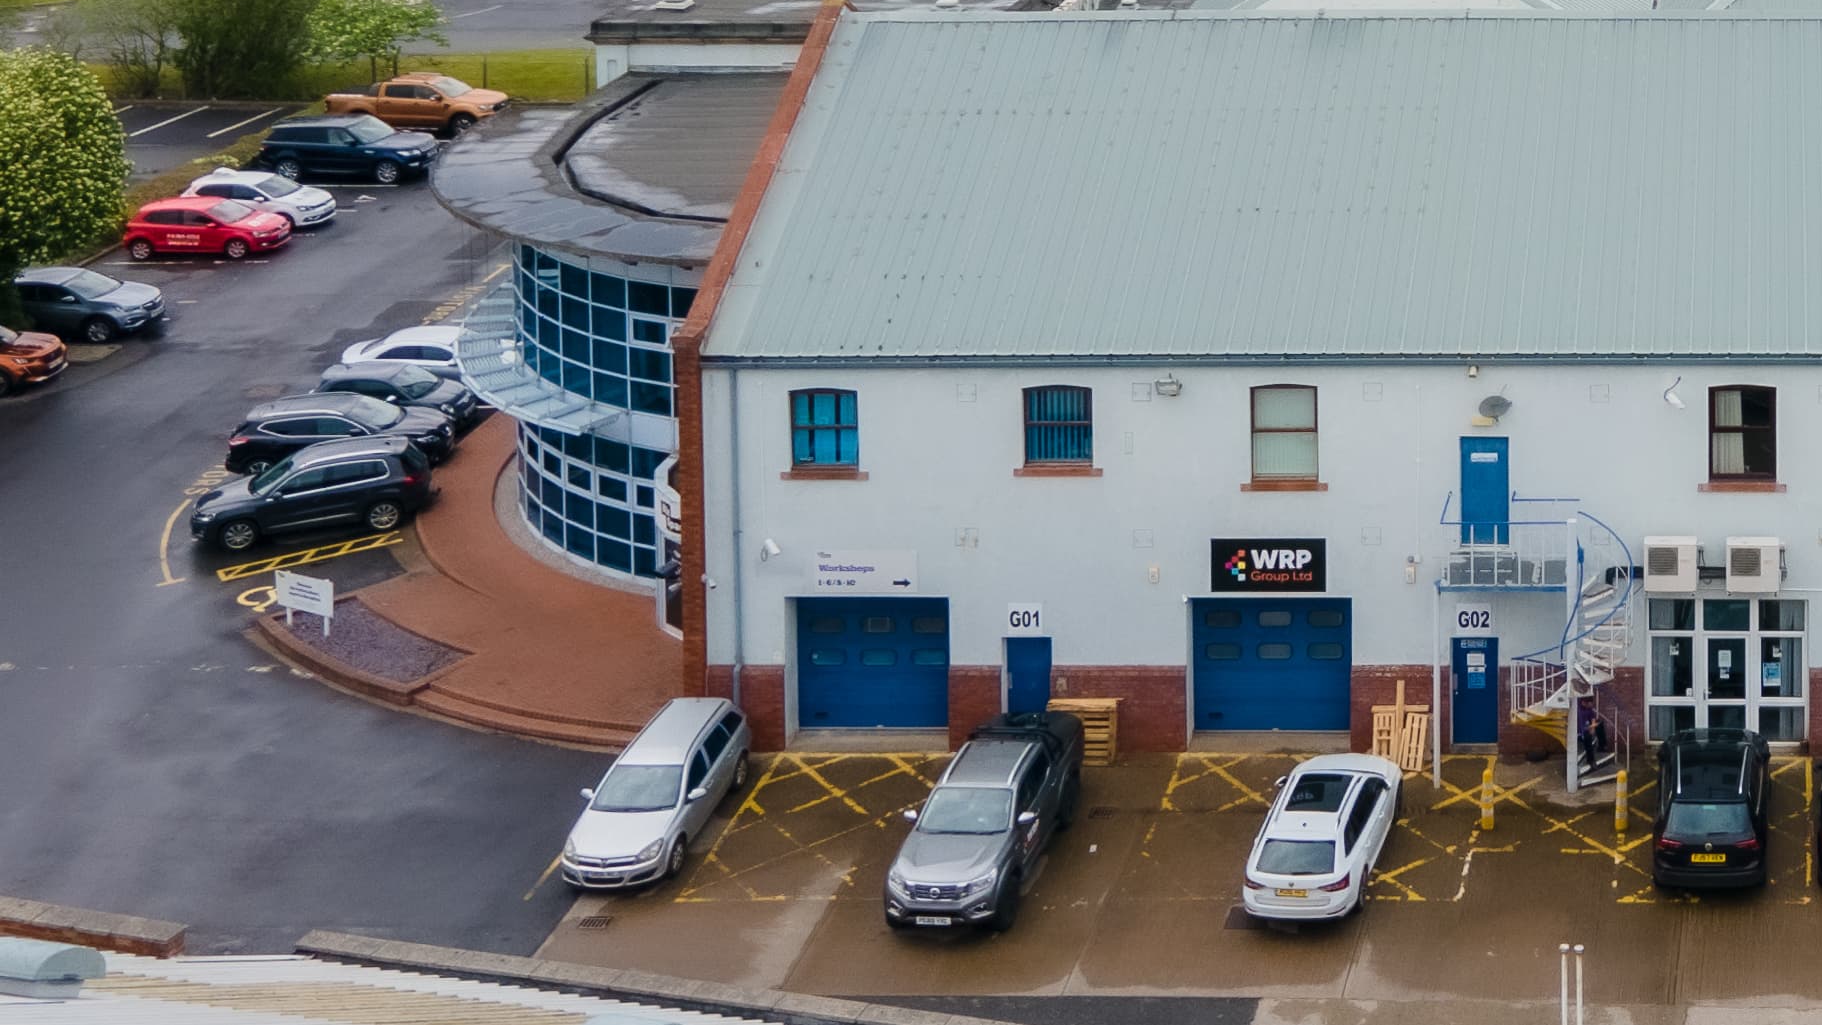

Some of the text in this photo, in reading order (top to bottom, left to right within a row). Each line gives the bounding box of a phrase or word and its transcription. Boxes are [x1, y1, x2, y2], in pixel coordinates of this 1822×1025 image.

[1250, 549, 1312, 569] WRP
[819, 565, 875, 574] Workshops
[1251, 571, 1313, 582] Group Ltd
[1010, 610, 1039, 627] G01
[1458, 610, 1490, 628] G02
